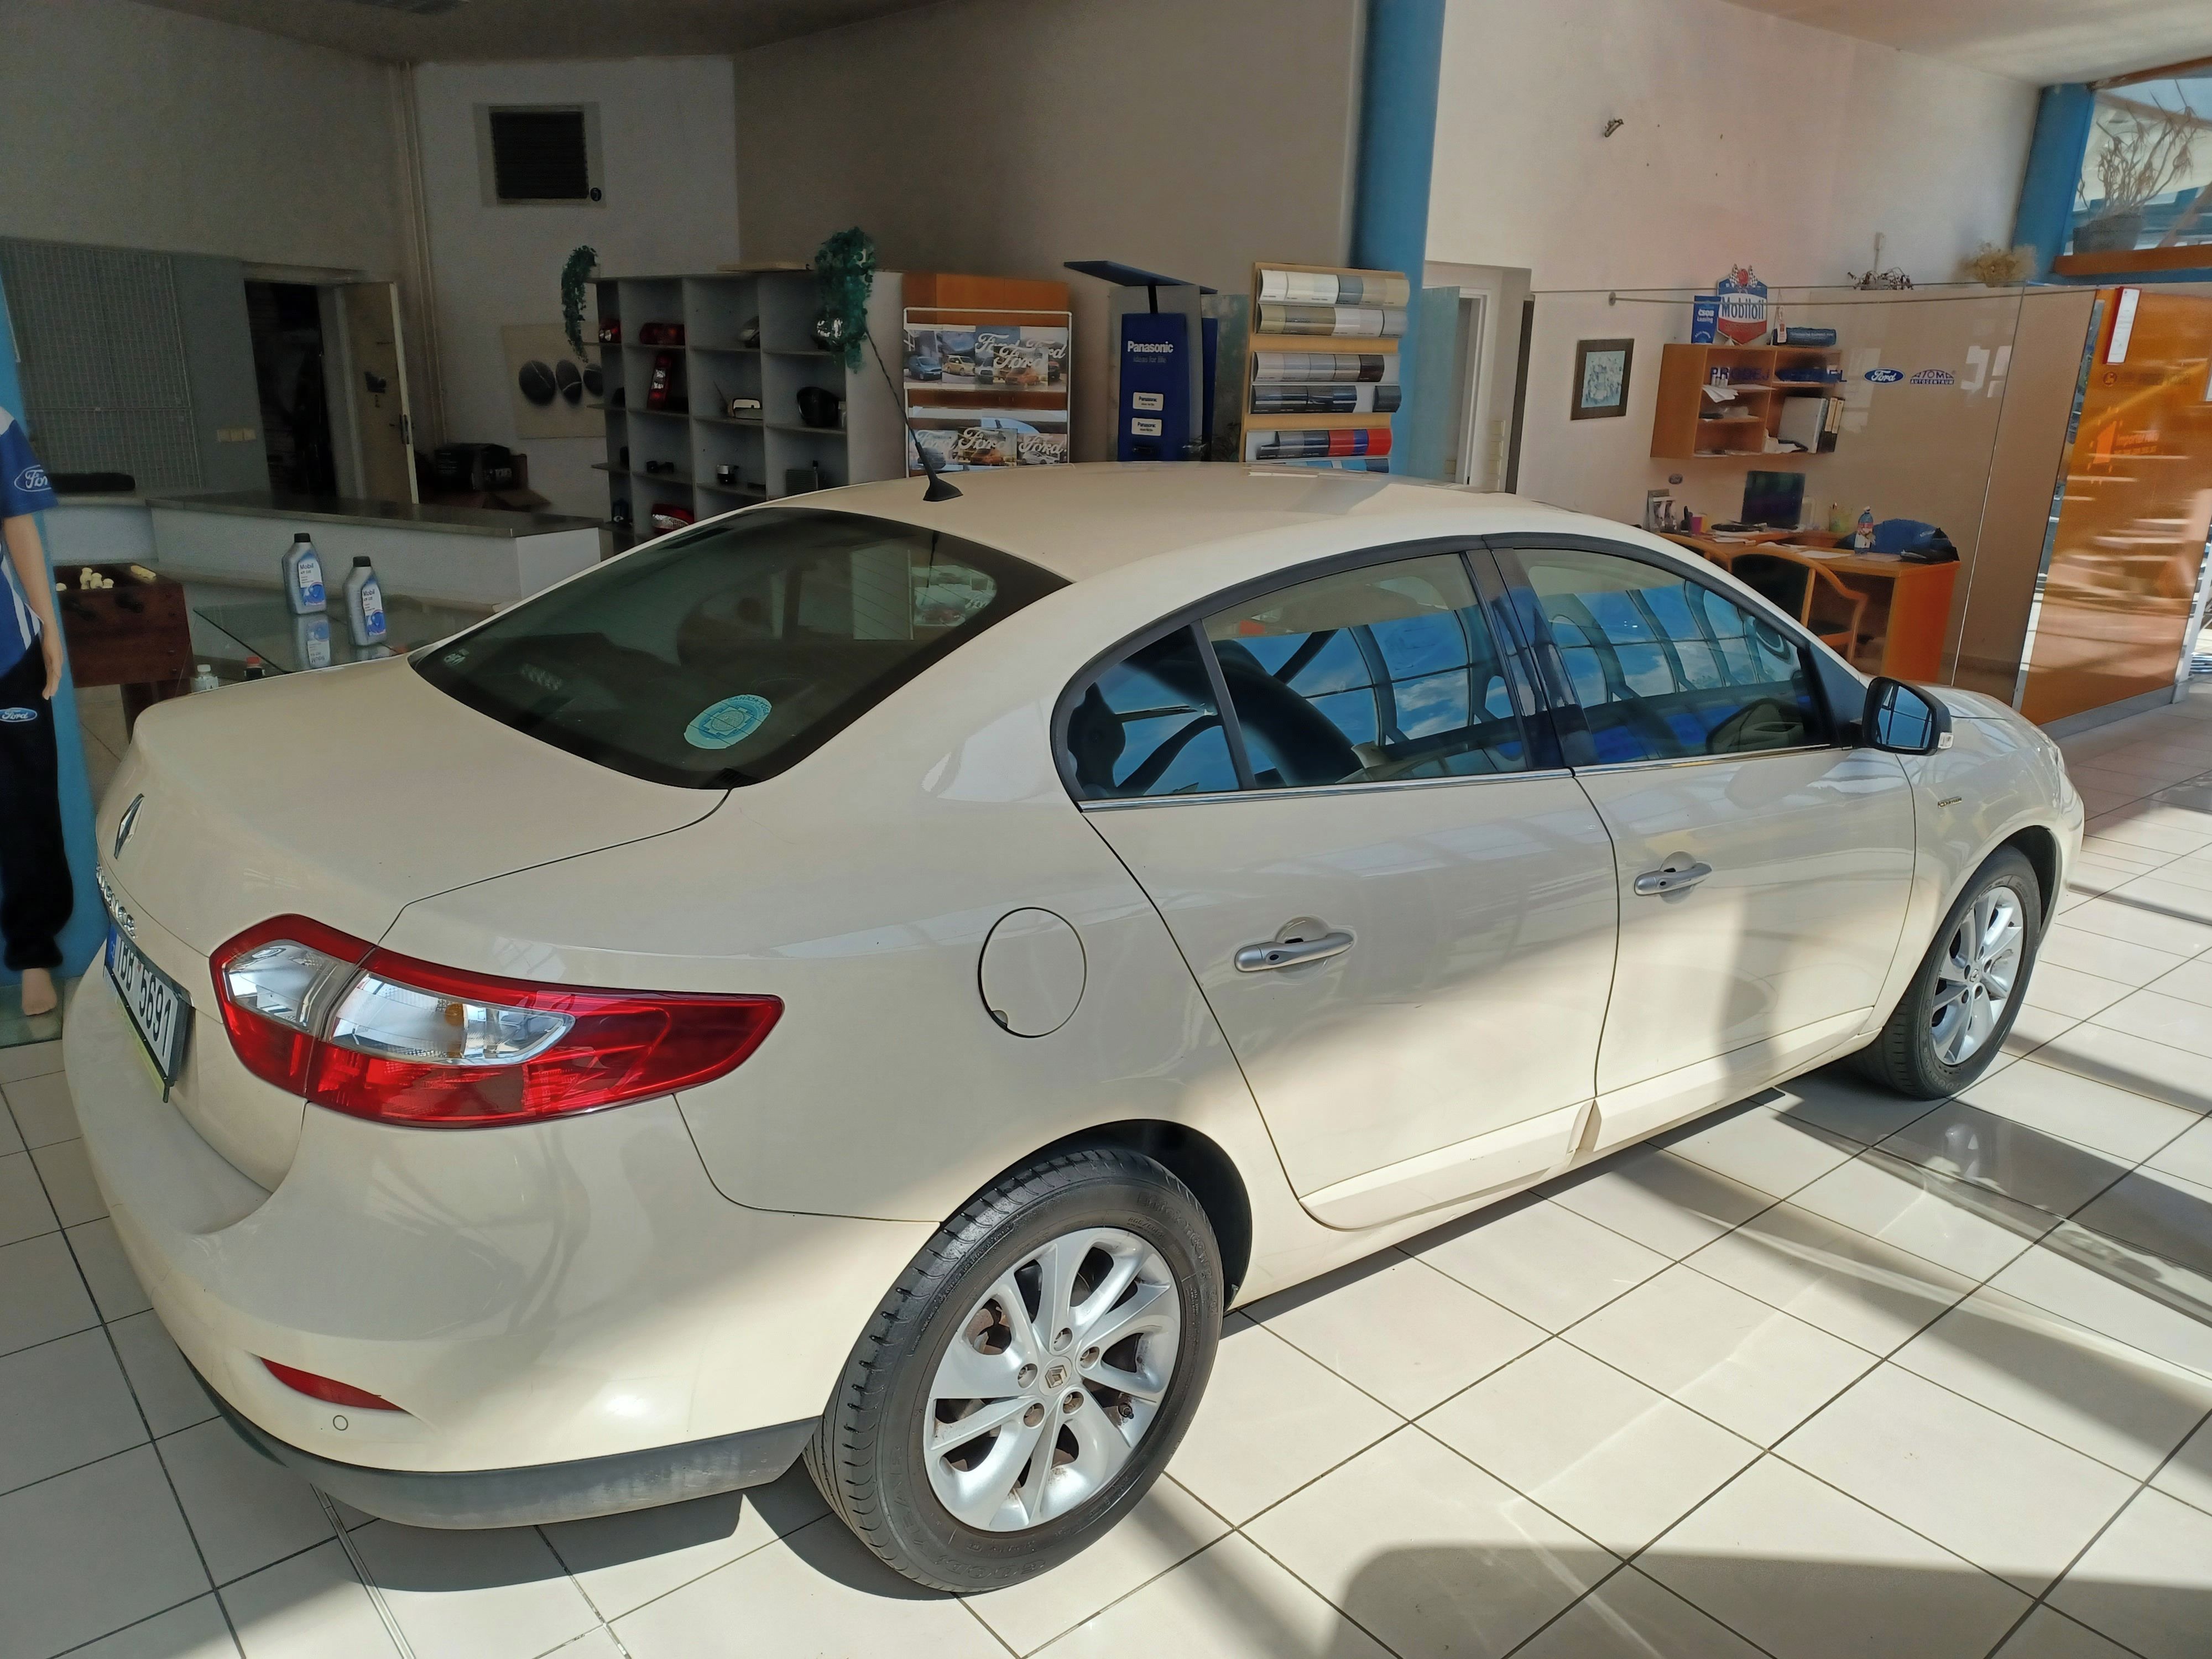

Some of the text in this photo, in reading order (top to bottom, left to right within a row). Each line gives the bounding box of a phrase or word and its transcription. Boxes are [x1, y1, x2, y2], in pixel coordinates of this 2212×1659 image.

[1721, 296, 1764, 320] Mobiloil
[1128, 341, 1173, 353] Panasonic
[1871, 371, 1897, 382] Ford
[1912, 369, 1954, 378] ATOMA
[958, 427, 1008, 450] Ford
[1019, 435, 1065, 455] Ford
[2, 710, 29, 719] Ford
[139, 969, 171, 1058] 5691
